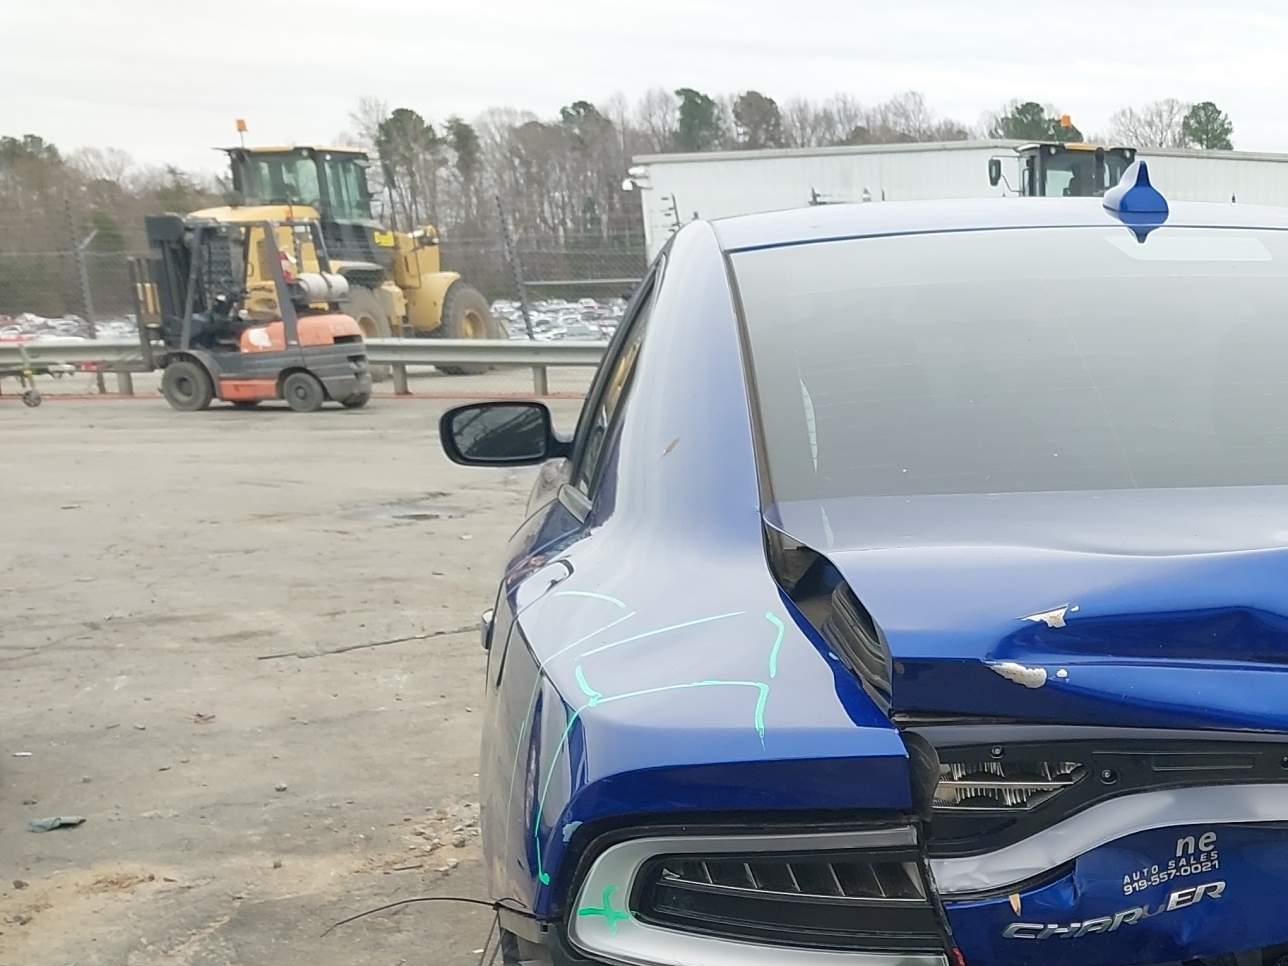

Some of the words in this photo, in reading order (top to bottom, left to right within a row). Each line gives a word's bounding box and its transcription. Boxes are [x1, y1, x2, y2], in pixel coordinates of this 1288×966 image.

[1175, 830, 1217, 857] ne
[1122, 864, 1160, 885] AUTO
[1168, 850, 1219, 868] SALES
[1123, 860, 1219, 896] 919-557-0021
